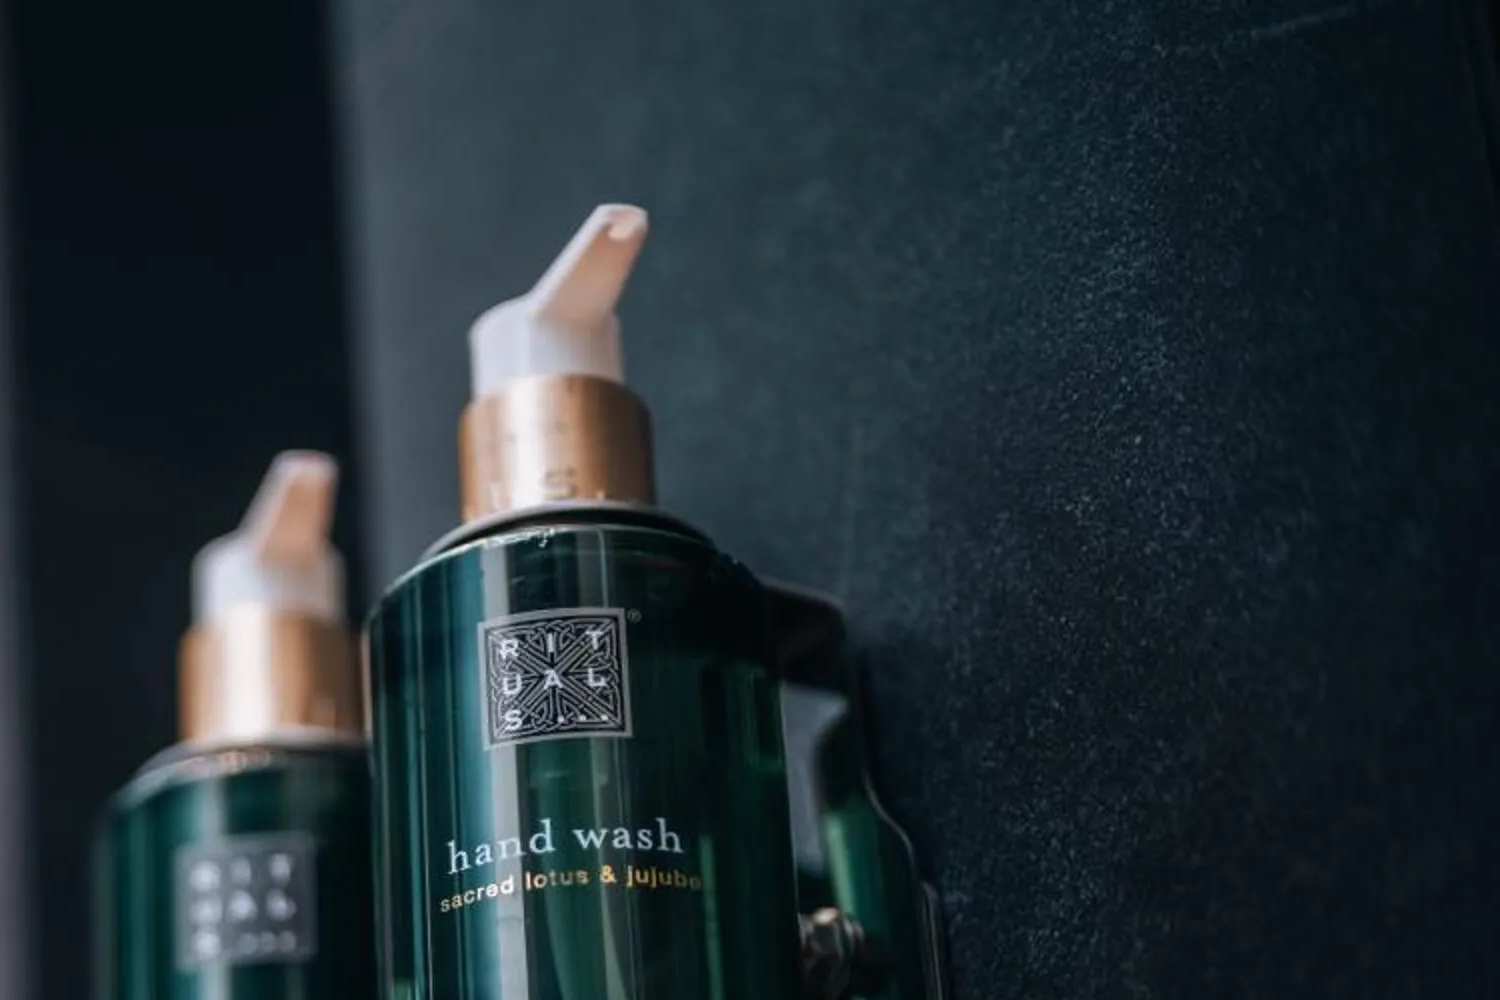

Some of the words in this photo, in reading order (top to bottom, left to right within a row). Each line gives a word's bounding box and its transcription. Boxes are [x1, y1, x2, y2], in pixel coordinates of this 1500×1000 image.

[447, 817, 556, 875] hand
[572, 816, 685, 854] wash
[439, 875, 515, 913] sacred
[524, 868, 591, 892] lotus
[599, 864, 618, 884] &
